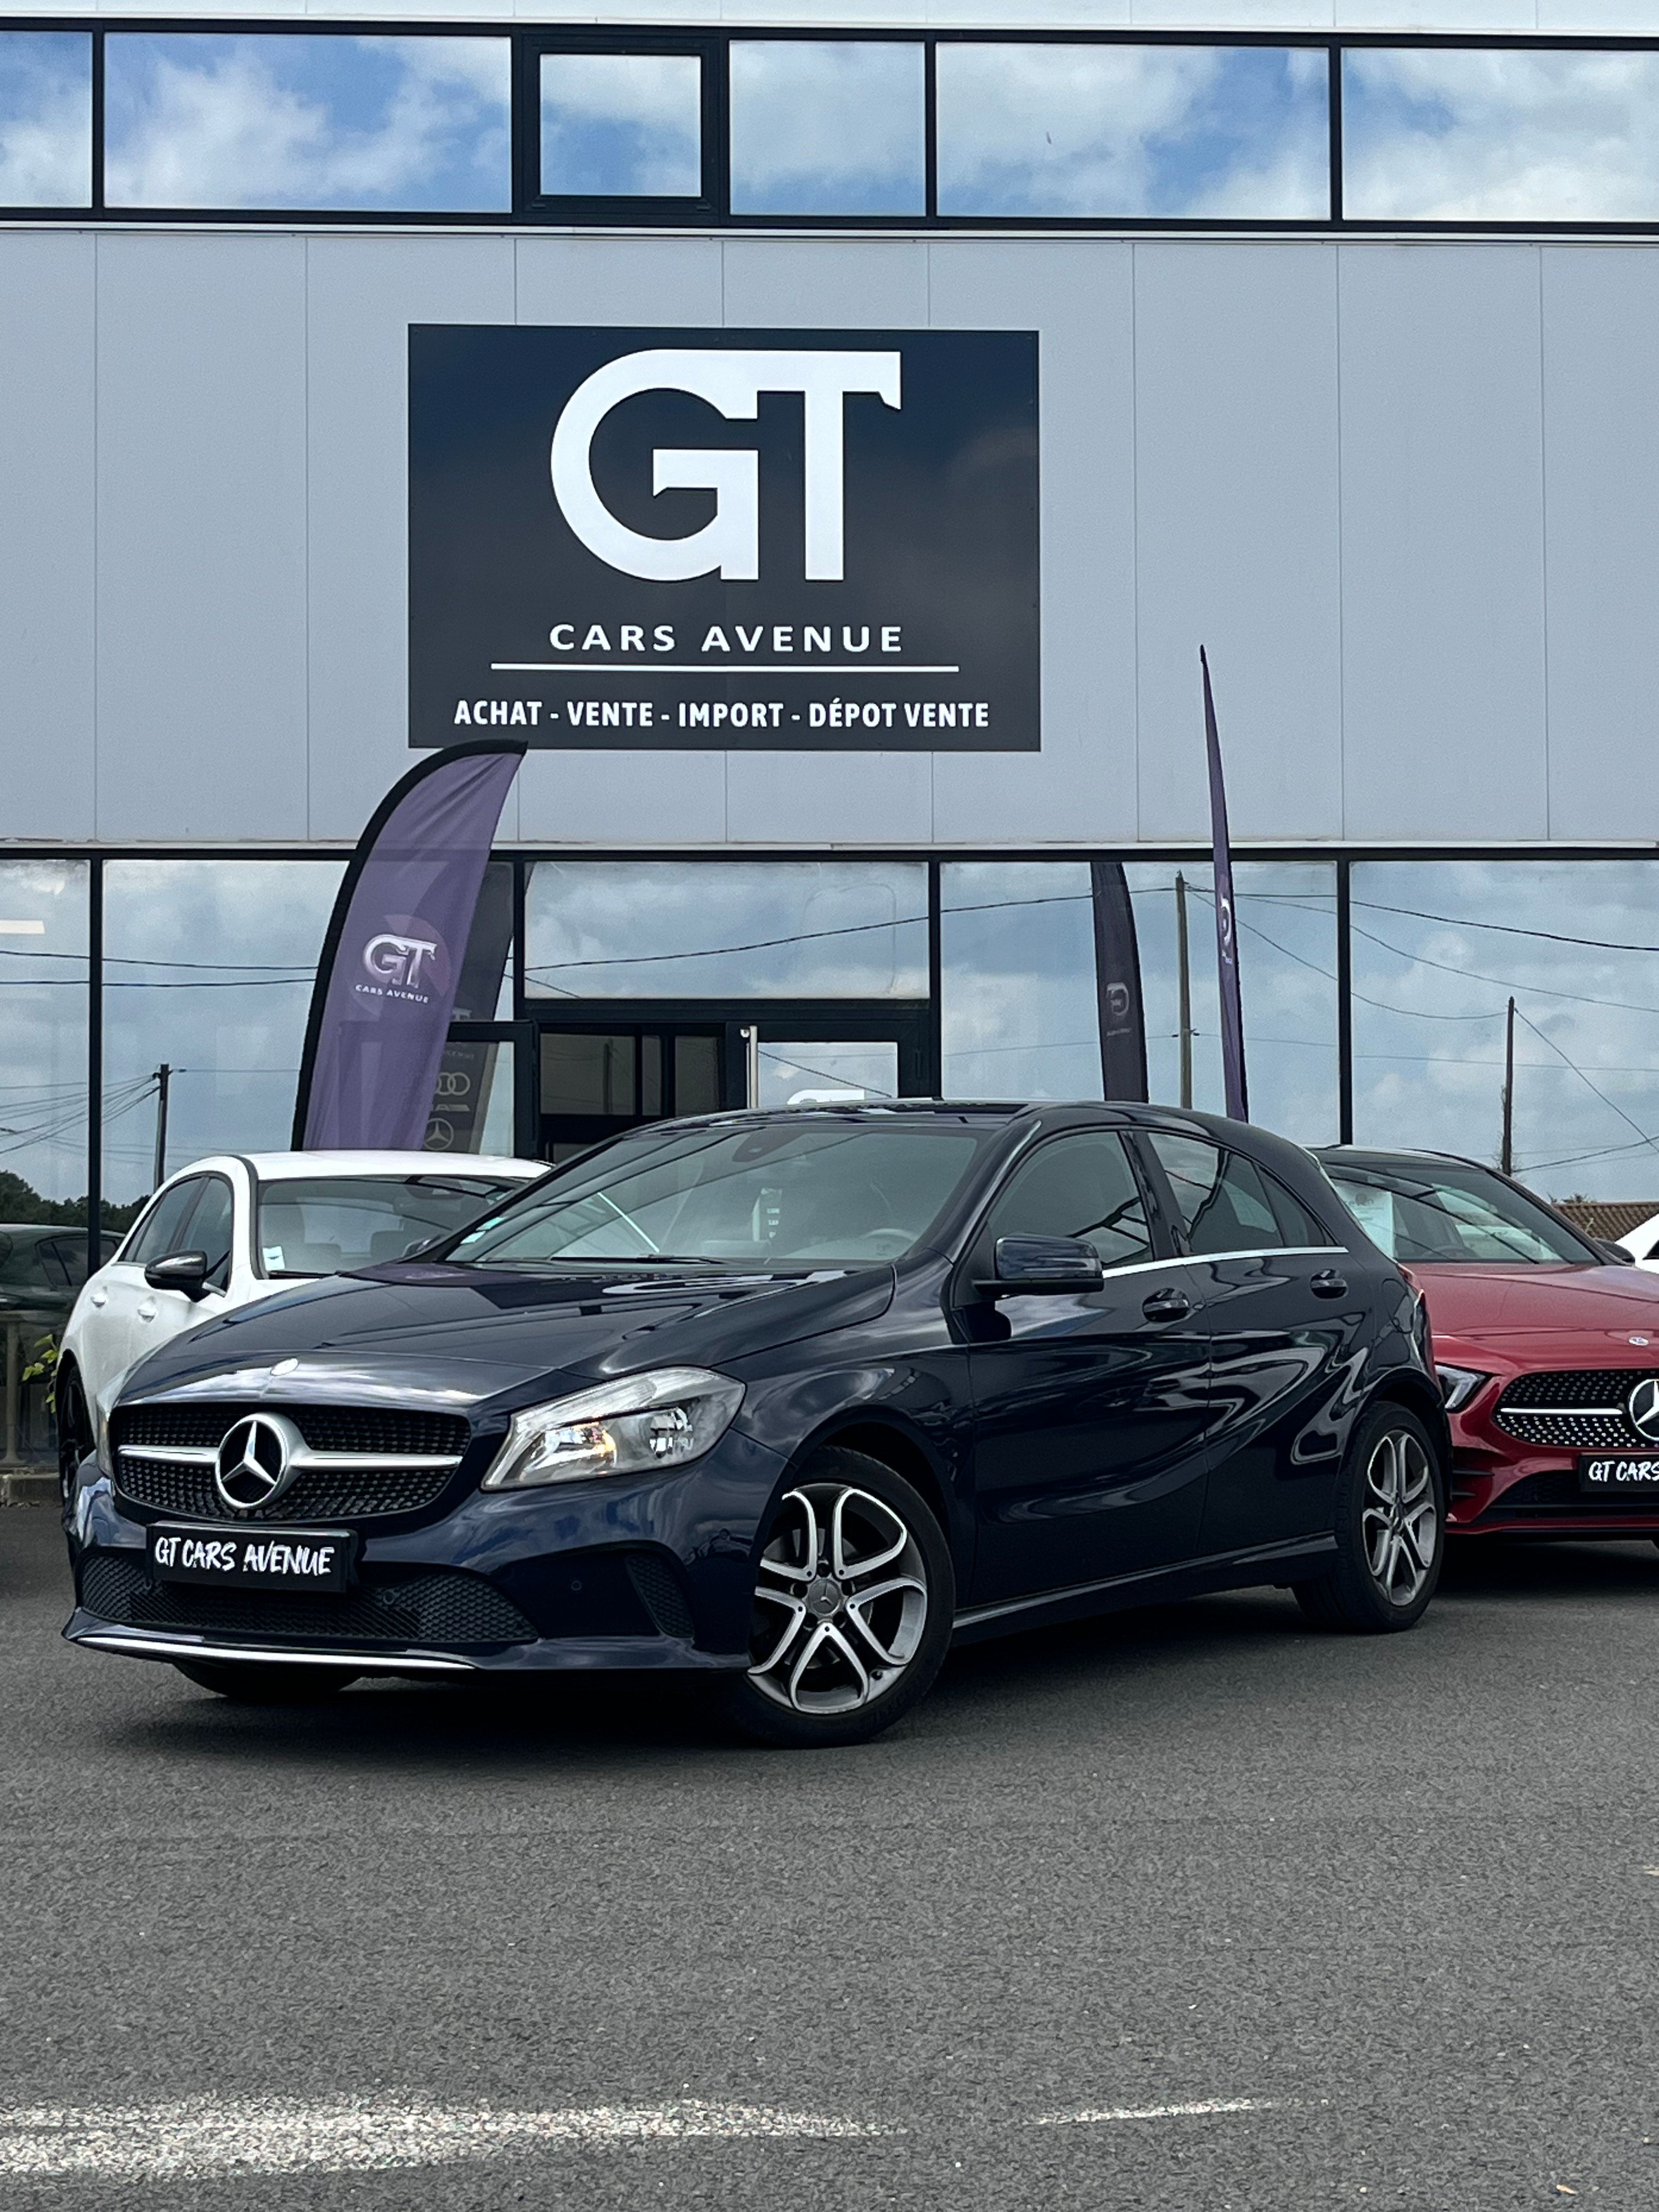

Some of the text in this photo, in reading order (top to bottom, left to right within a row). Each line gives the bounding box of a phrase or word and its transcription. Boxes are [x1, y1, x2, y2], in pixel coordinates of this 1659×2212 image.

[550, 349, 901, 581] GT
[550, 624, 901, 652] CARS AVENUE
[454, 700, 542, 725] ACHAT
[567, 701, 653, 726] VENTE
[679, 703, 783, 727] IMPORT
[809, 697, 897, 727] DÉPOT
[904, 703, 989, 727] VENTE
[363, 934, 437, 989] GT
[356, 984, 430, 1004] CARS AVENUE
[1588, 1460, 1615, 1482] GT
[155, 1537, 335, 1576] GT CARS AVENUE
